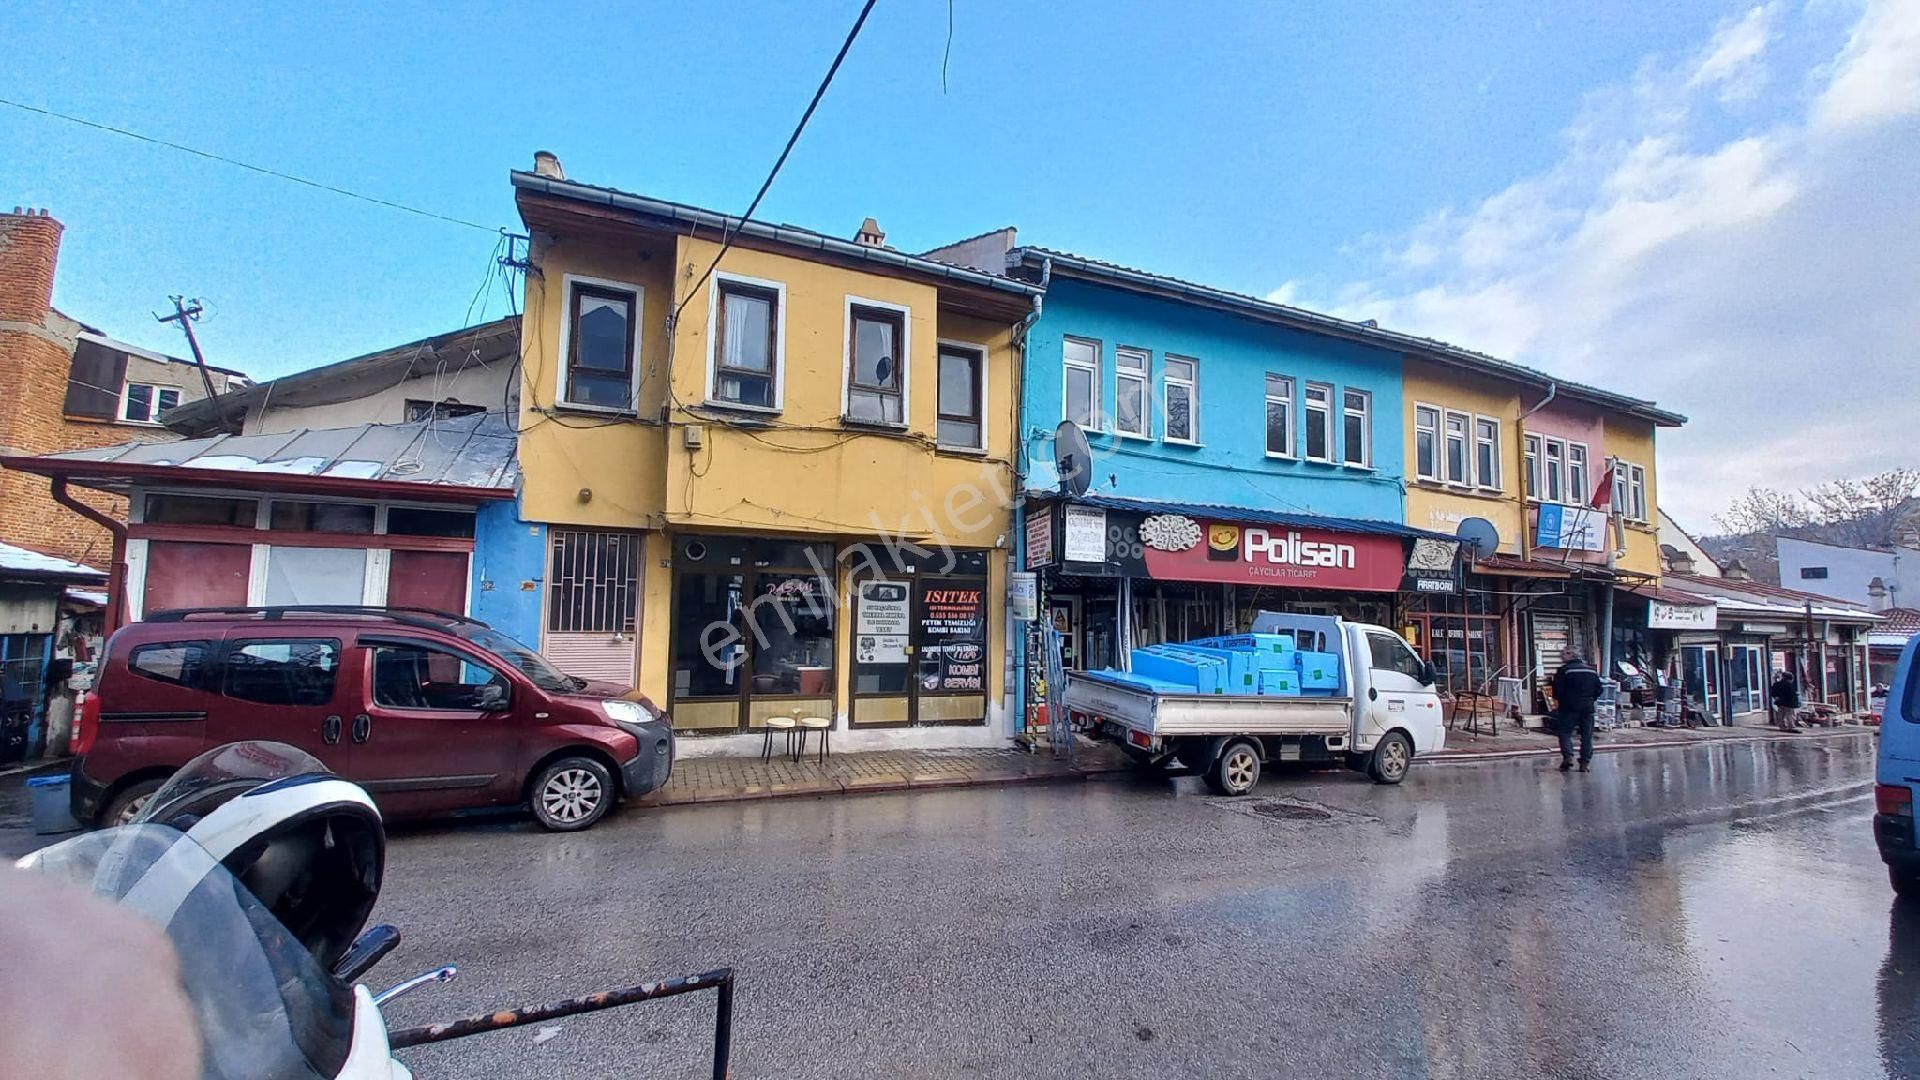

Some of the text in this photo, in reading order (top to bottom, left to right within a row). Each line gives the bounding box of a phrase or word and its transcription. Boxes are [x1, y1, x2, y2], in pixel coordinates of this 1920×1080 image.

[1244, 528, 1355, 568] Polisan
[1249, 566, 1286, 577] ÇAYCILAR
[924, 590, 981, 603] ISITEK
